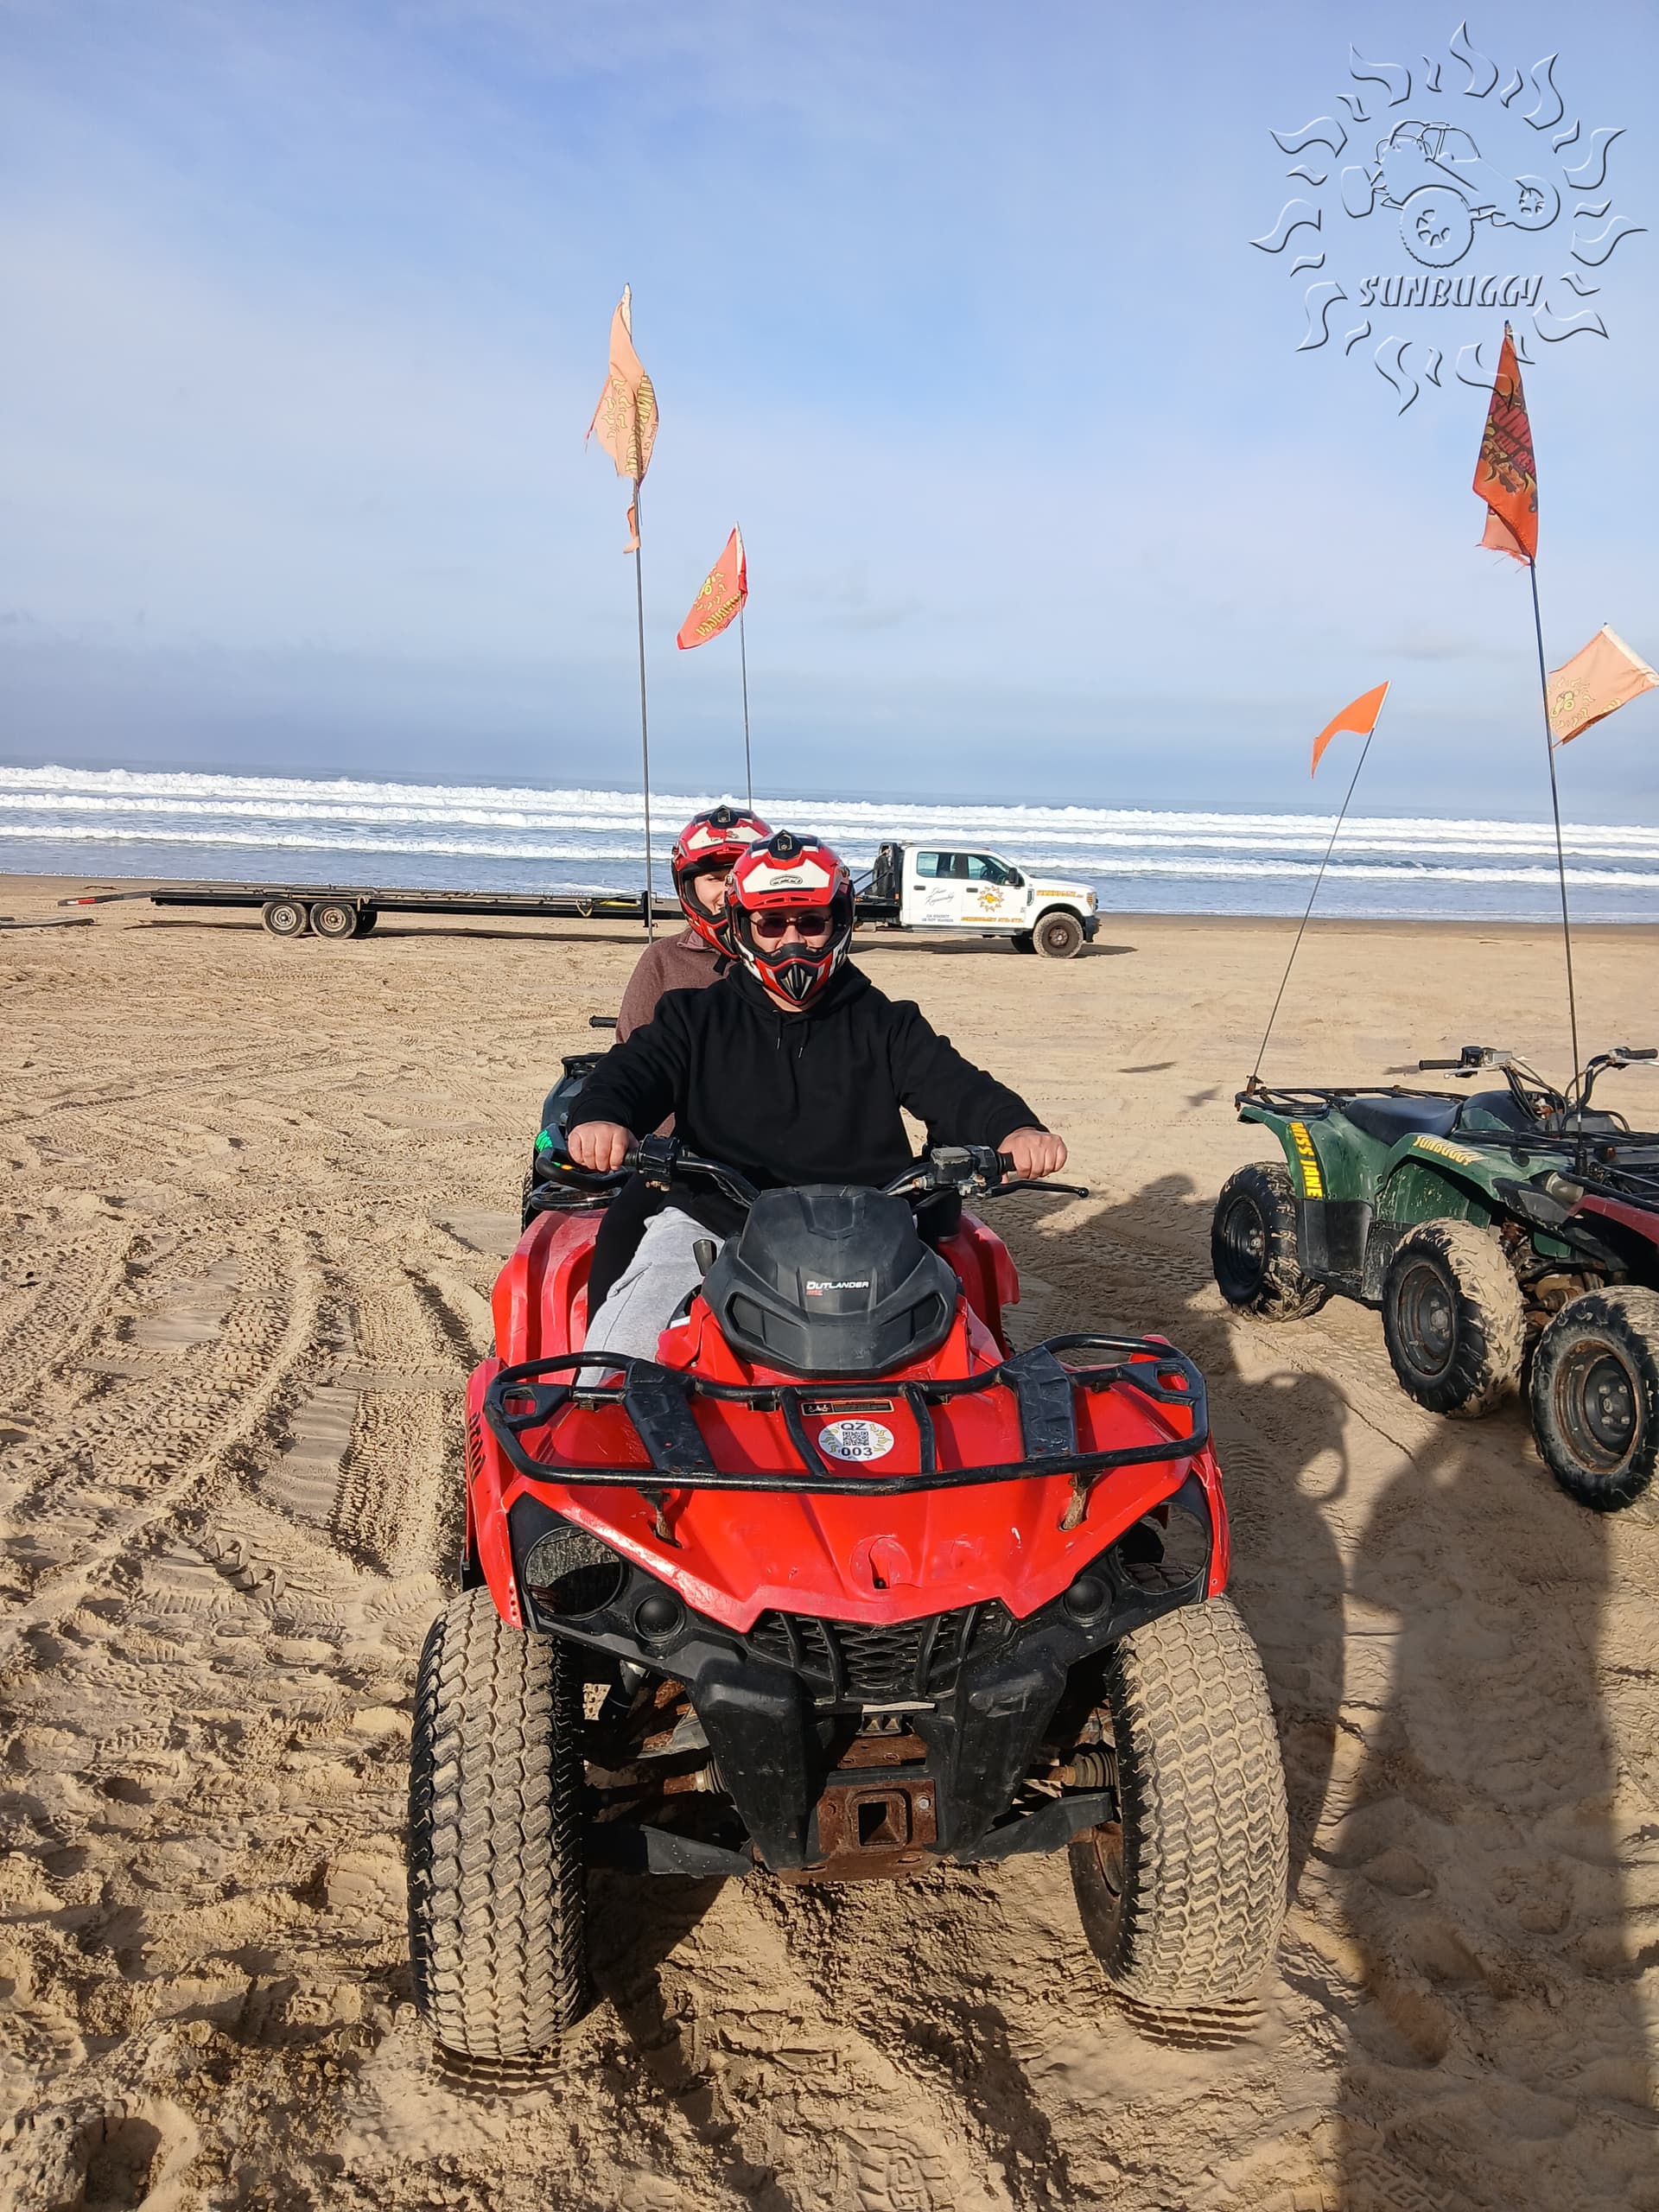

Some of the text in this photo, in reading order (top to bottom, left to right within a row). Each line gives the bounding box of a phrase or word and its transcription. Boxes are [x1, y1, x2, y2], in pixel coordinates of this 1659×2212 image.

[1289, 1122, 1323, 1198] MISS JANE
[806, 1281, 869, 1289] OUTLANDER
[841, 1422, 868, 1431] QZ
[841, 1447, 873, 1457] 003
